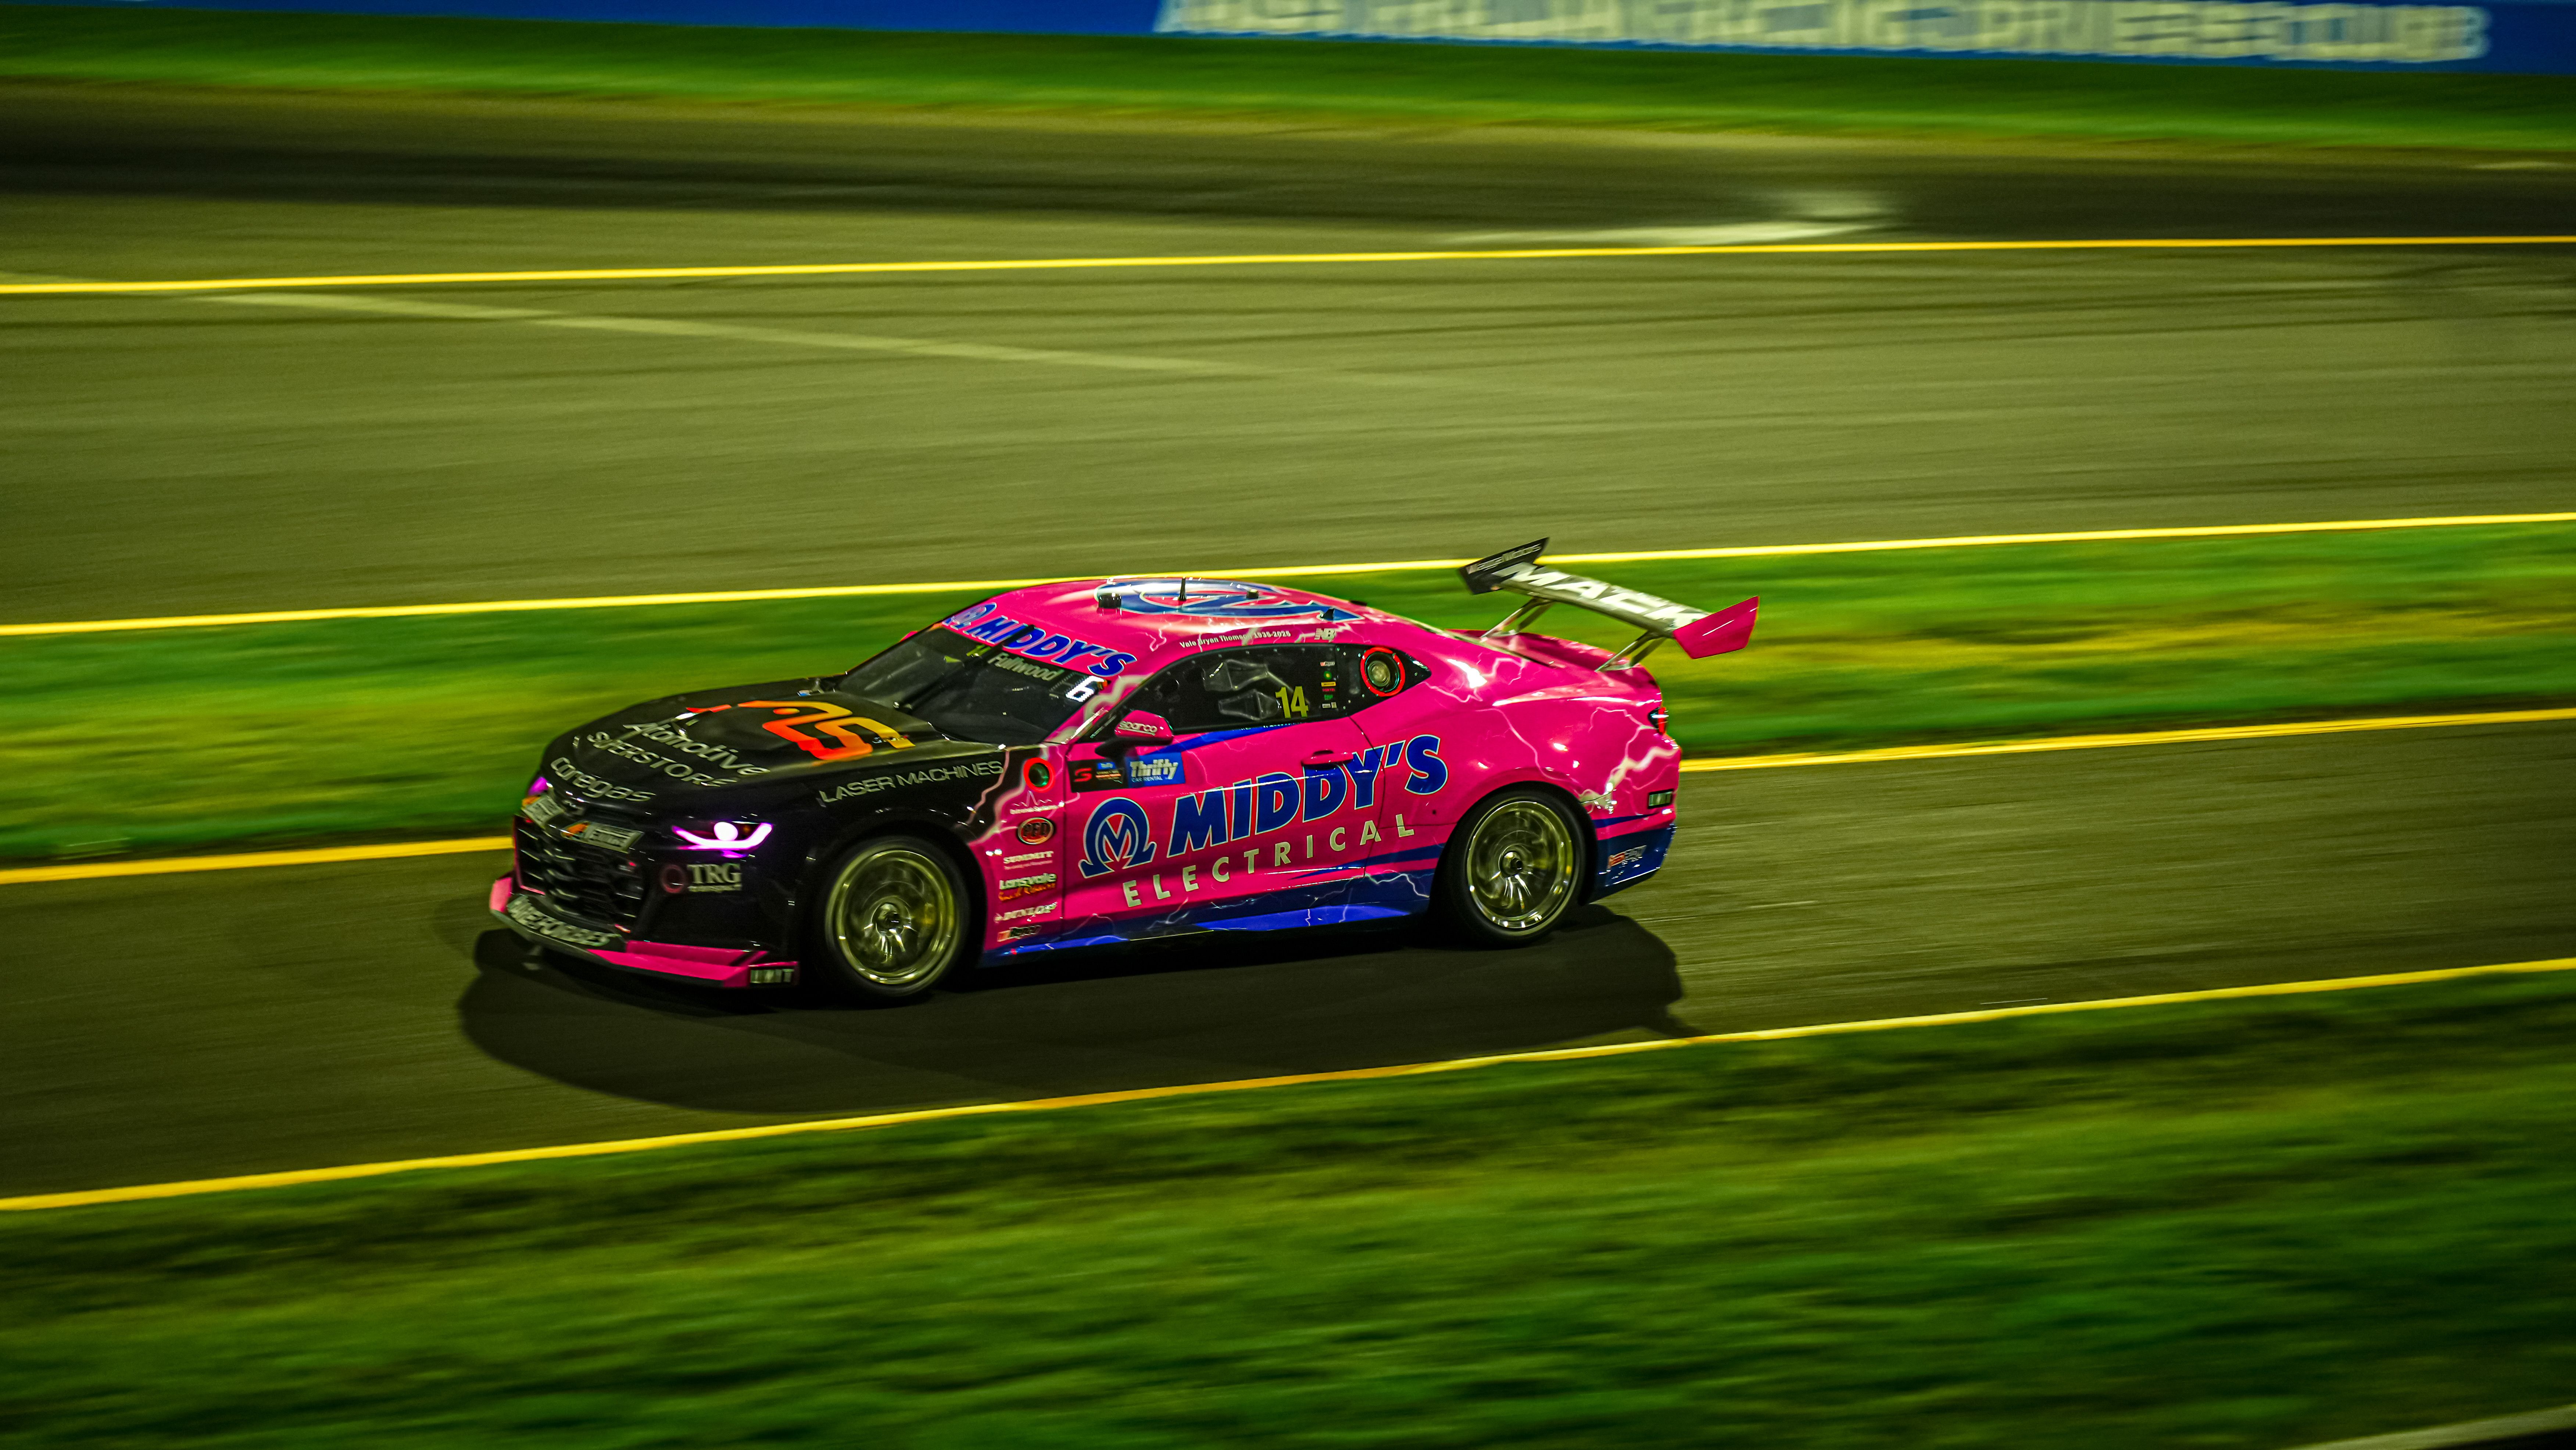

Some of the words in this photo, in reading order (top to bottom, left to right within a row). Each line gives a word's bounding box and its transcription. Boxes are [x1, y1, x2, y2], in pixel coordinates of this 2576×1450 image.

[1492, 562, 1710, 633] MACK
[962, 615, 1137, 677] MIDDY'S
[1066, 675, 1105, 702] 6
[1275, 685, 1309, 719] 14
[623, 722, 771, 775] Atomotive
[1119, 721, 1158, 733] sparco
[551, 757, 656, 801] Coregas
[819, 776, 896, 803] LASER
[895, 761, 1004, 786] MACHINES
[1130, 758, 1179, 780] Thrifty
[1166, 734, 1449, 858] MIDDY'S
[686, 863, 742, 884] TRG
[1122, 813, 1414, 908] ELECTRICAL
